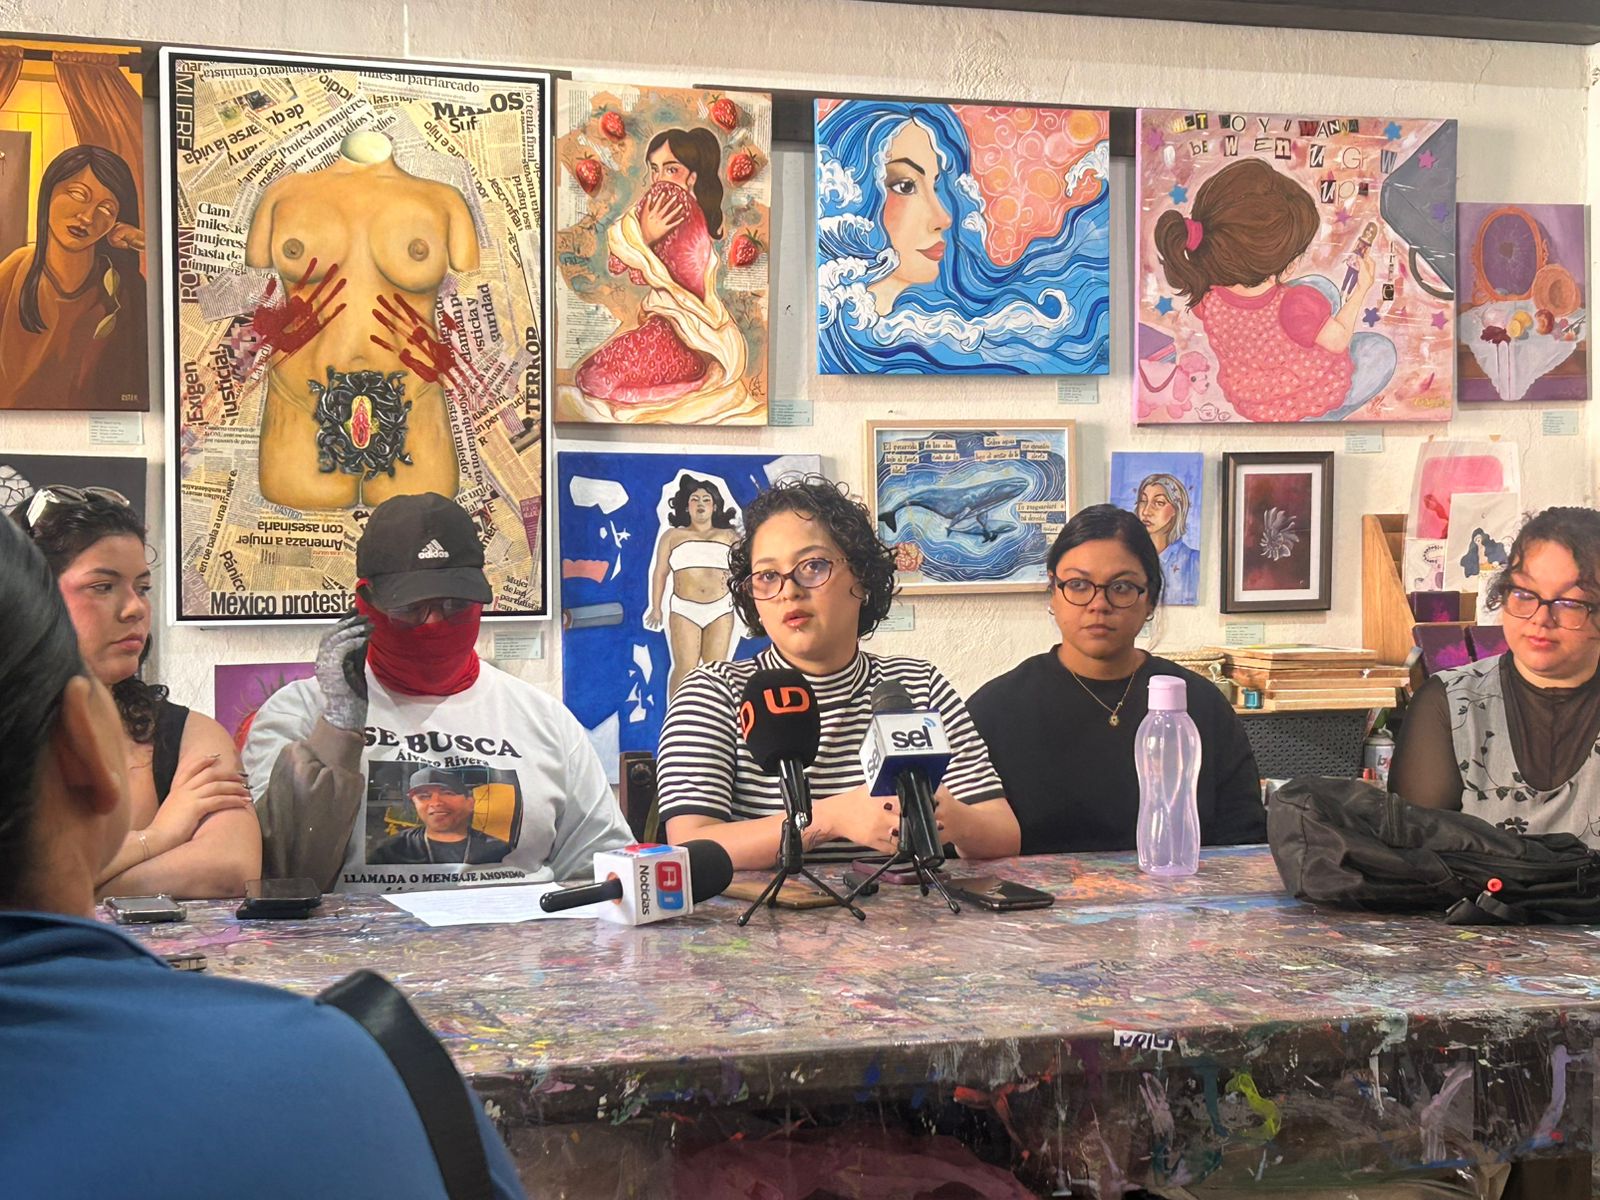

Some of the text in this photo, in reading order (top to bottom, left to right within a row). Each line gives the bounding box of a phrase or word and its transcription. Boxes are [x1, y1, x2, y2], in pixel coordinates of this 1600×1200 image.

[408, 74, 480, 93] patriarcado
[214, 136, 231, 151] la
[278, 124, 329, 159] Protestan
[182, 145, 216, 165] vida
[184, 361, 206, 422] Exigen
[258, 520, 343, 535] con asesinarla
[236, 531, 273, 548] mujer
[285, 539, 344, 551] Amenaza
[210, 591, 277, 615] México
[364, 726, 522, 758] SE BUSCA
[891, 725, 933, 748] sel
[444, 755, 490, 768] Rivera
[343, 874, 406, 884] LLAMADA
[409, 874, 419, 884] O
[422, 871, 478, 884] MENSAJE
[639, 864, 651, 916] Noticias
